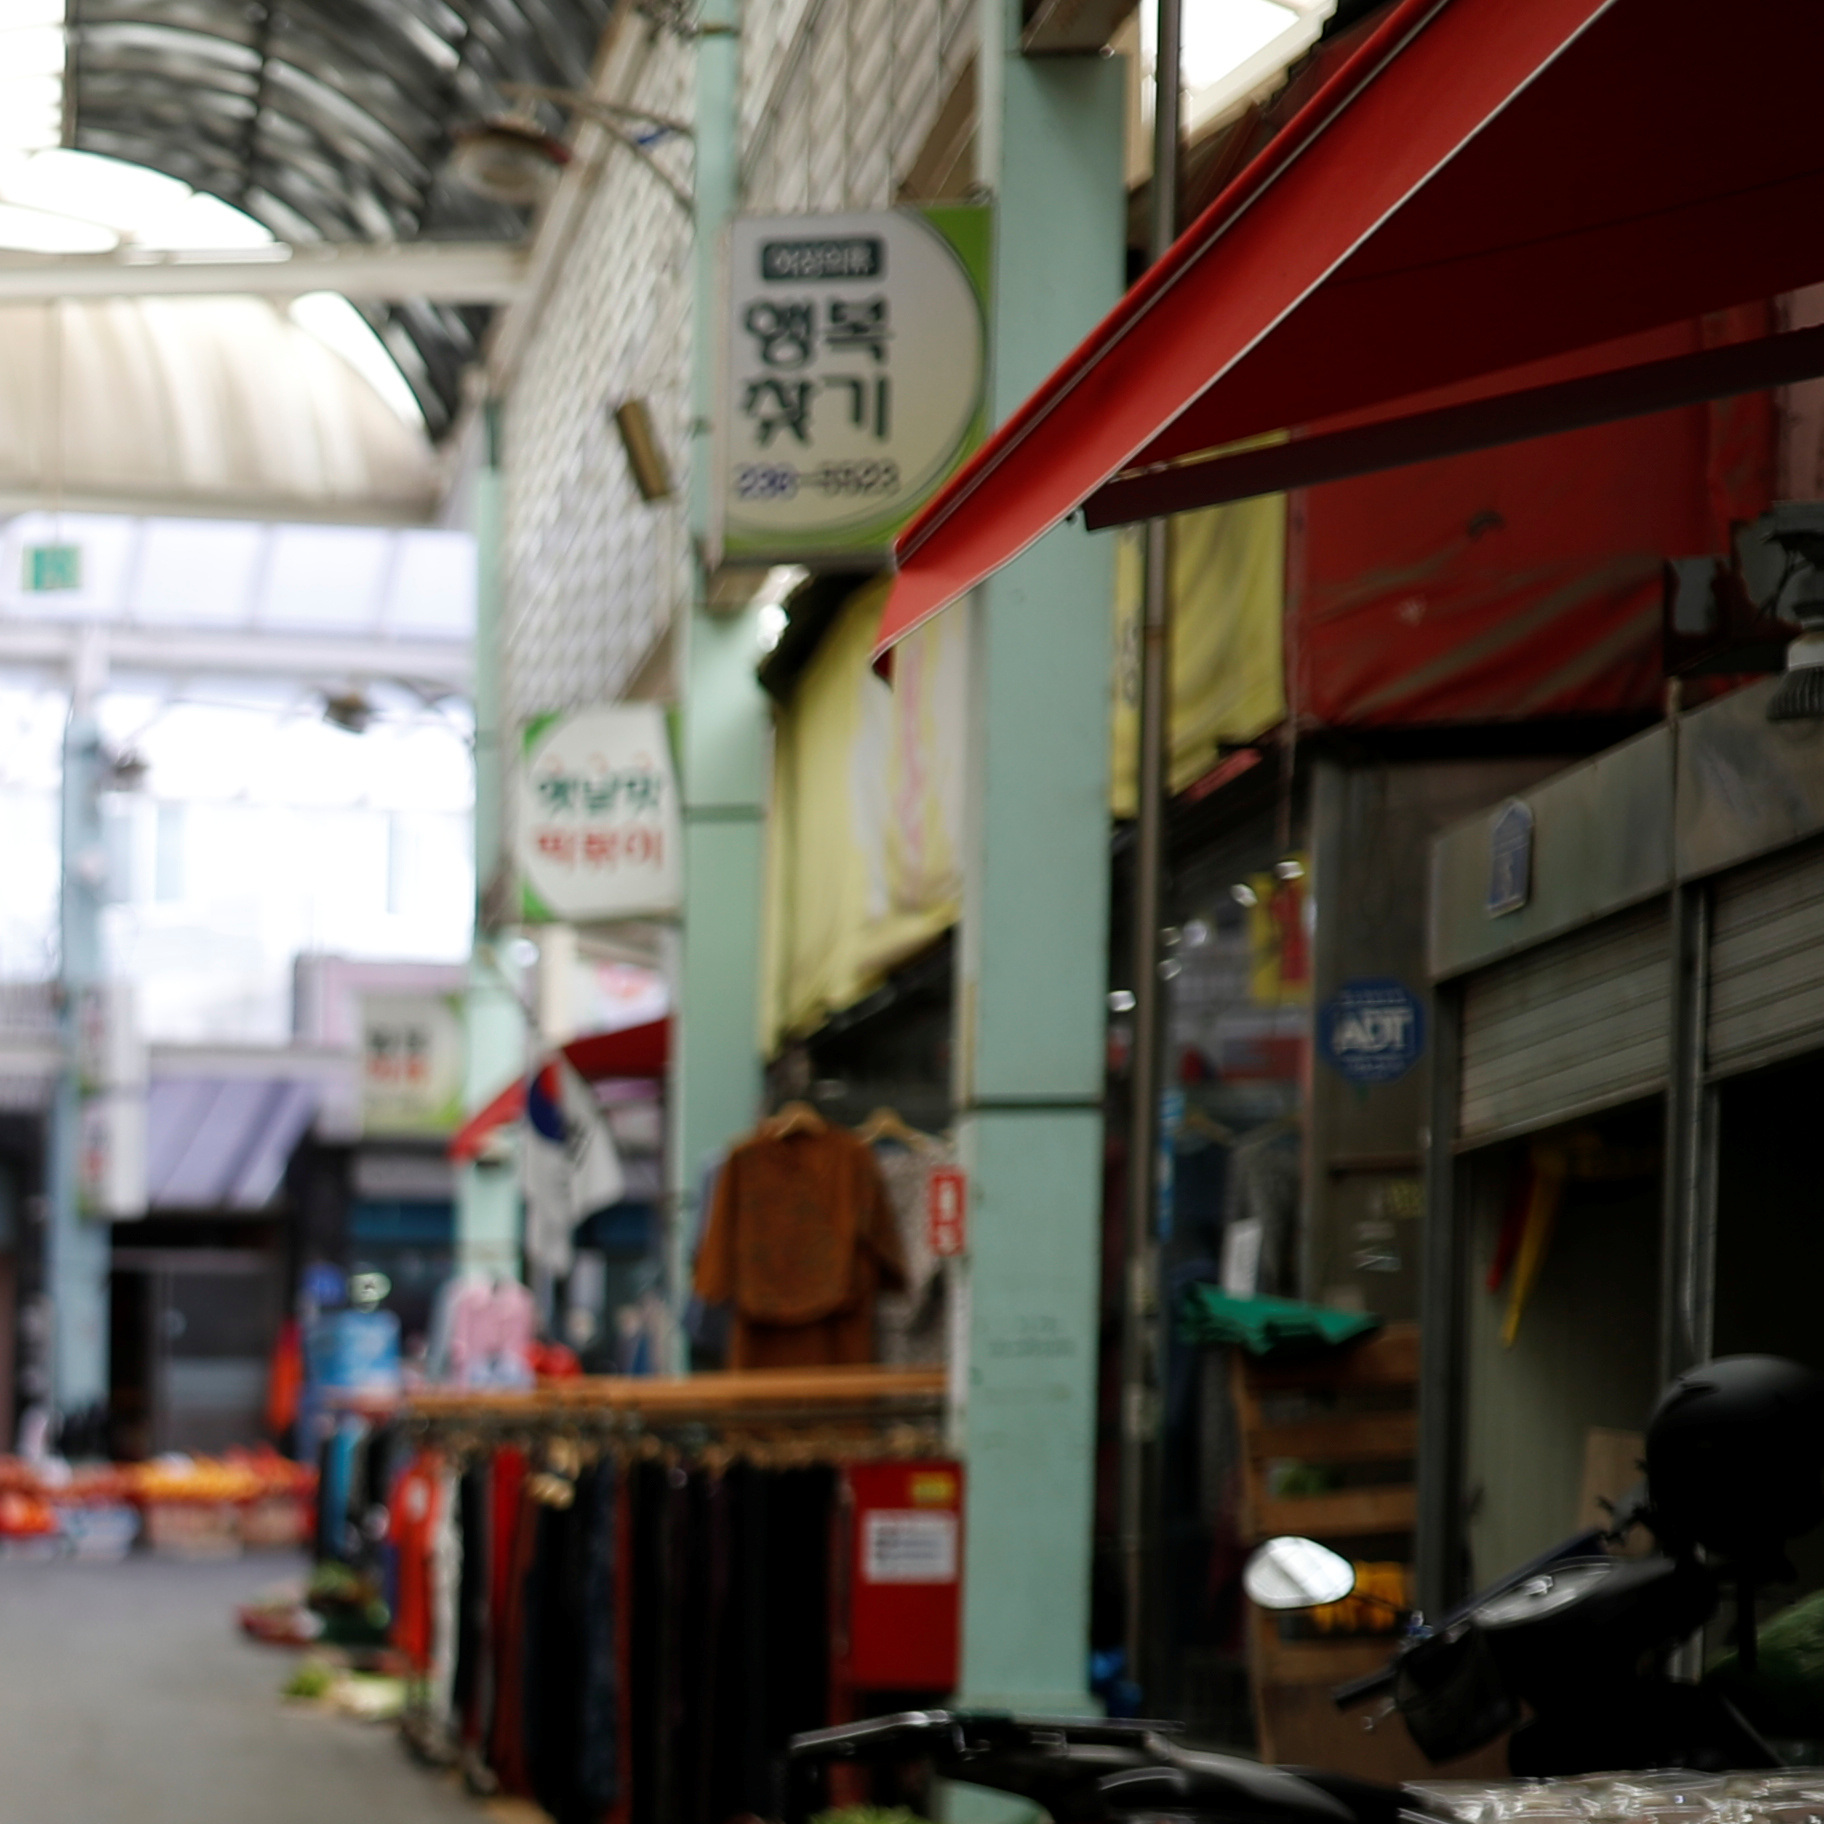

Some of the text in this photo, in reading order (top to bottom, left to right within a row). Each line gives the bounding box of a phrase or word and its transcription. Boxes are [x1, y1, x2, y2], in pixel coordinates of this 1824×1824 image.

[745, 298, 895, 371] 행복
[743, 376, 890, 448] 찾기
[1332, 1006, 1414, 1055] ADT
